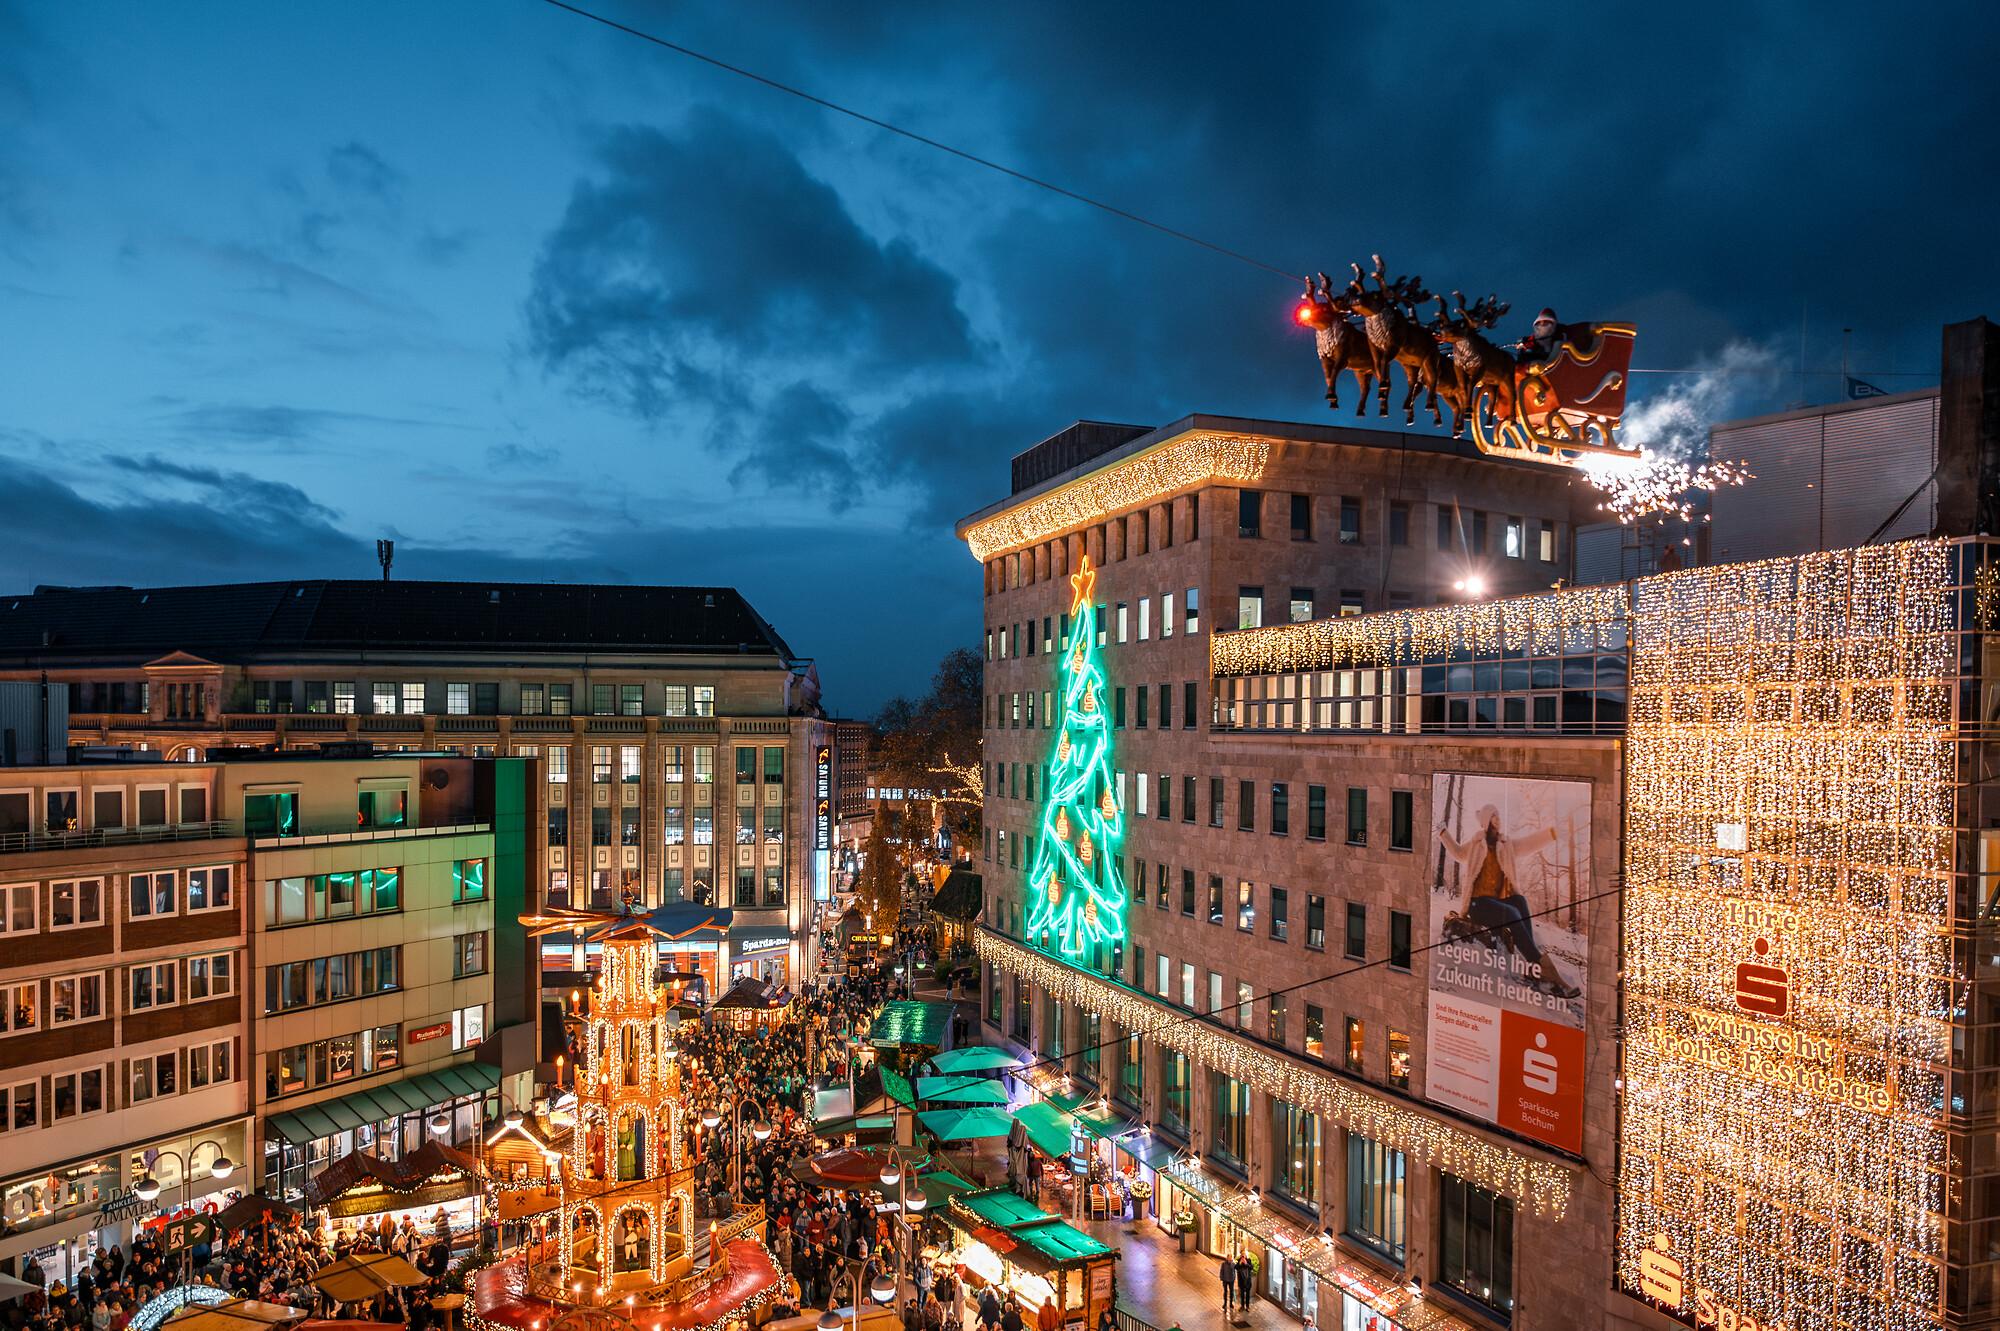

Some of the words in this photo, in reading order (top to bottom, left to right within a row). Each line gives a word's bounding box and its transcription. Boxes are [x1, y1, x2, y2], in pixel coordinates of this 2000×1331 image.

[818, 764, 829, 798] SATURN
[818, 815, 829, 849] SATURN
[1729, 902, 1799, 932] Ihre
[1438, 941, 1480, 965] Legen
[1483, 948, 1507, 971] Sie
[1511, 954, 1542, 978] Ihre
[1436, 963, 1494, 994] Zukunft
[1497, 977, 1543, 1006] heute
[1546, 995, 1572, 1013] an.
[1693, 1012, 1833, 1062] wünscht
[1650, 1027, 1730, 1066] frohe
[1743, 1050, 1889, 1109] Festtage
[1518, 1098, 1560, 1120] Sparkasse
[1521, 1112, 1555, 1132] Bochum
[93, 1198, 160, 1230] ZIMMER
